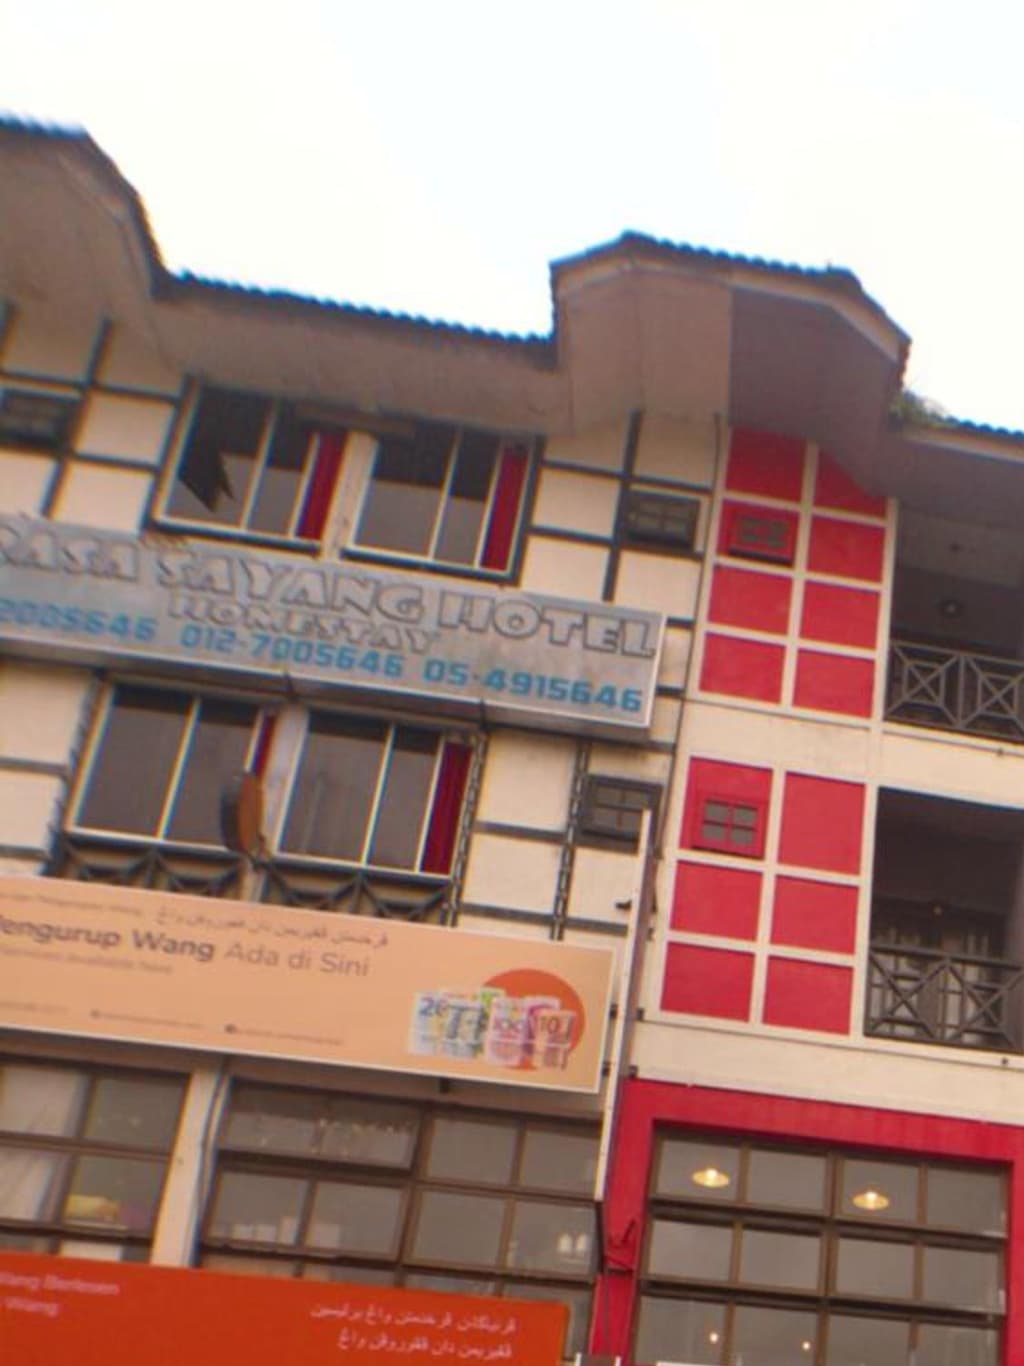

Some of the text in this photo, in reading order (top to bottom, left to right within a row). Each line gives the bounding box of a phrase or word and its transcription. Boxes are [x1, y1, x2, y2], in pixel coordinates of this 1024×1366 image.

[156, 547, 424, 625] SAYANG
[438, 588, 657, 659] HOTEL
[167, 590, 438, 656] HOMESTAY
[180, 623, 404, 678] 012-7005646
[422, 657, 643, 713] 05-4915646
[0, 914, 122, 948] engurup
[132, 928, 216, 963] Wang
[222, 941, 279, 967] Ada
[287, 946, 312, 969] di
[320, 950, 371, 978] Sini
